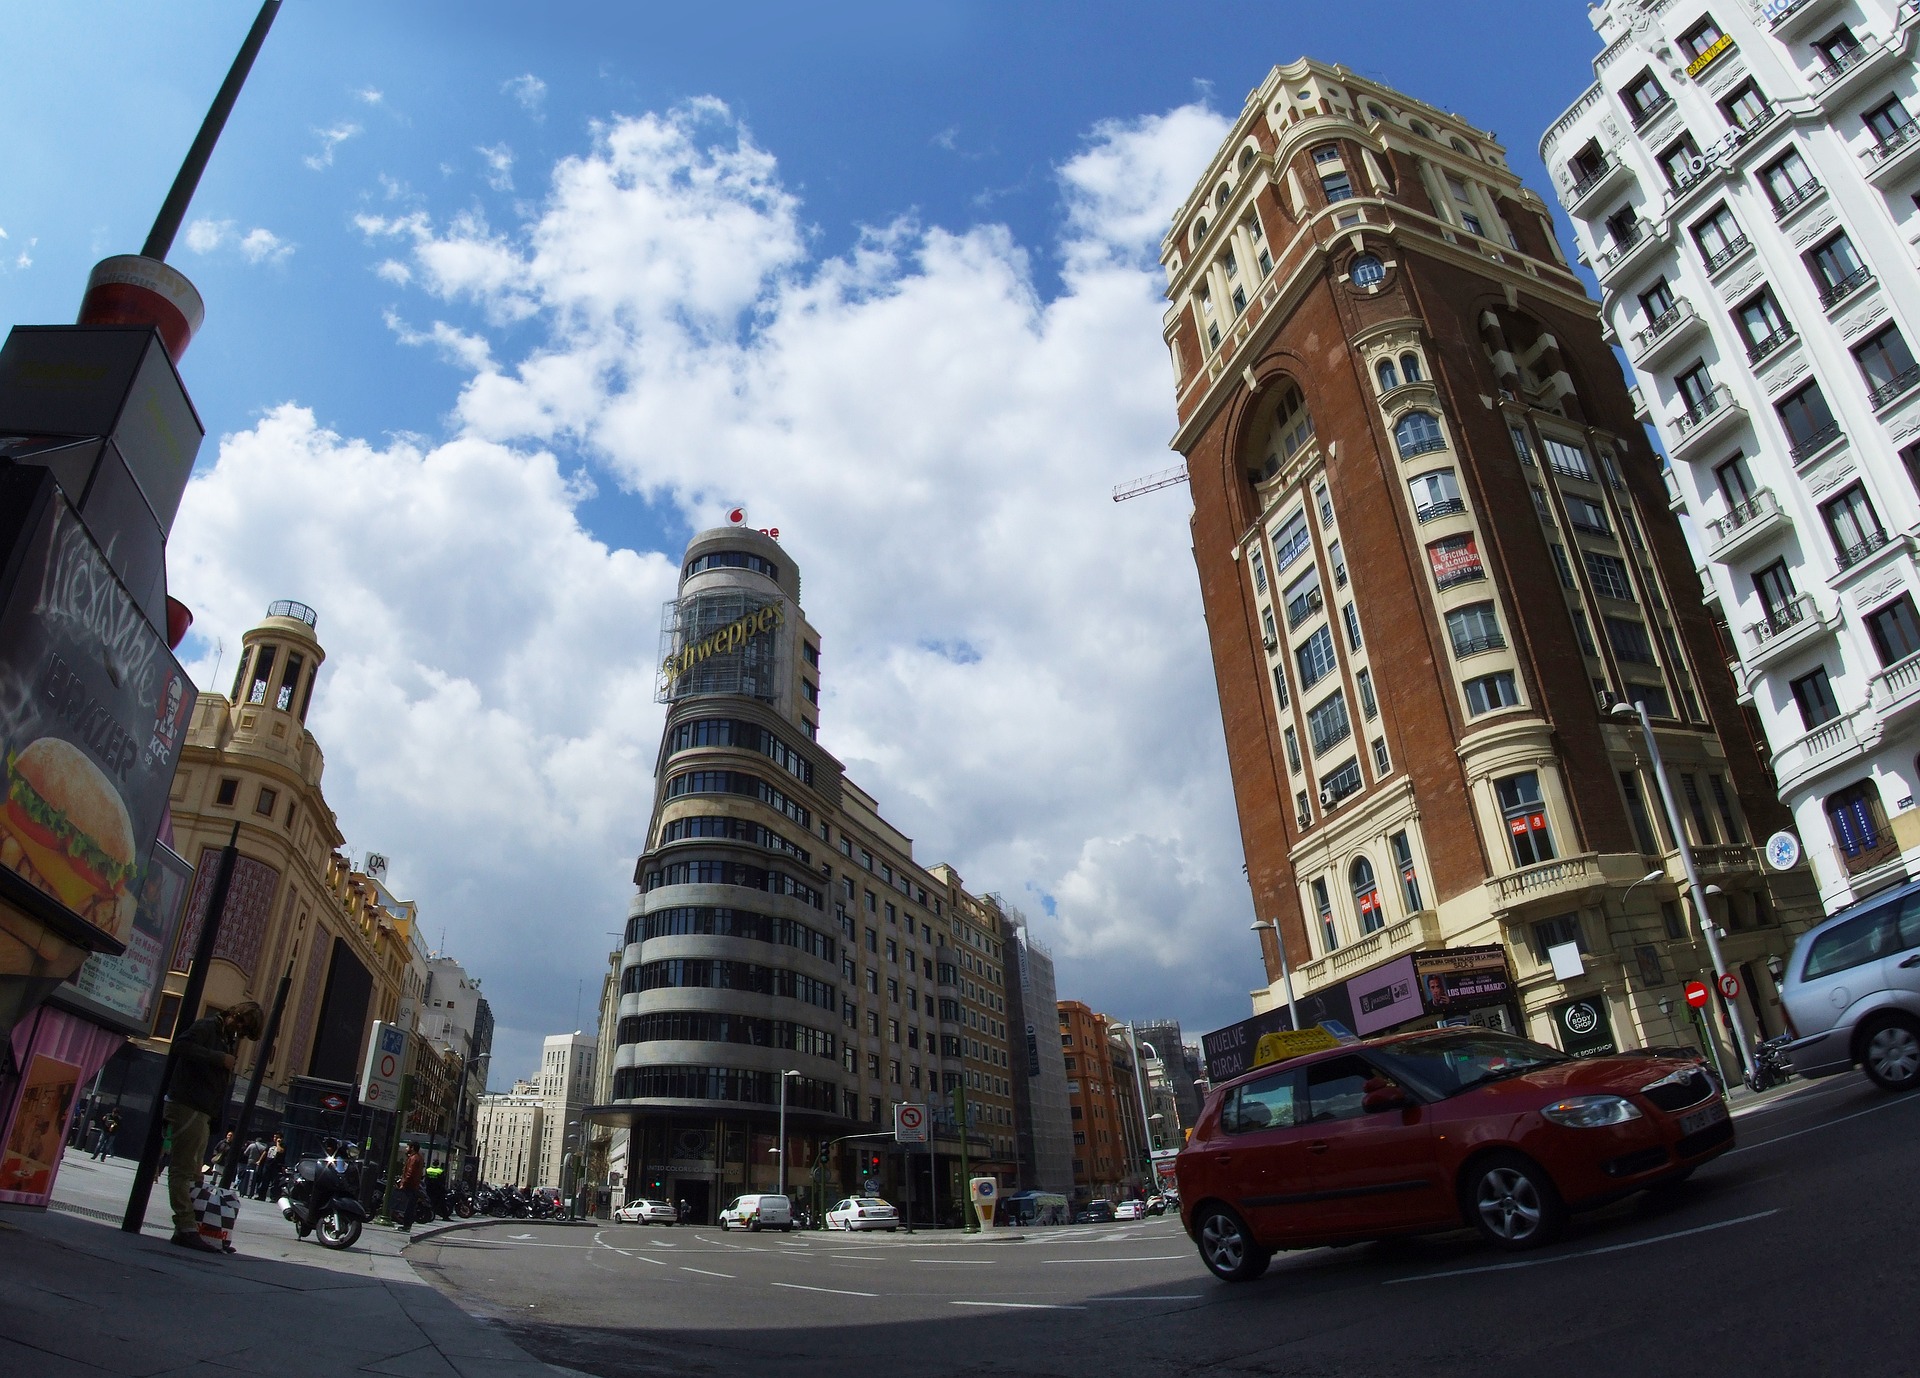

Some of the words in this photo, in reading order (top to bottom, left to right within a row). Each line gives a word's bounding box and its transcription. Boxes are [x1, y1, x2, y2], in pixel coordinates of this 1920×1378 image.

[1687, 56, 1708, 76] GRAN
[1707, 45, 1720, 58] VIA
[1721, 35, 1731, 47] 44
[1673, 117, 1760, 189] HOSTAL
[1433, 562, 1444, 572] EN
[1445, 553, 1480, 568] ALQUILER
[1440, 548, 1469, 563] OFICINA
[660, 599, 785, 692] Schweppes
[148, 734, 170, 765] KFC
[1454, 961, 1468, 969] SALA
[1447, 988, 1460, 997] LOS
[1460, 986, 1475, 995] IDUS
[1475, 985, 1483, 993] DE
[1484, 982, 1507, 992] MARZO
[1572, 1014, 1591, 1025] BODY
[1574, 1020, 1592, 1030] SHOP
[1326, 1024, 1346, 1036] L
[1580, 1047, 1597, 1057] BODY
[1597, 1043, 1613, 1053] SHOP
[1211, 1053, 1244, 1078] CIRCA!
[665, 1165, 692, 1173] COLORS
